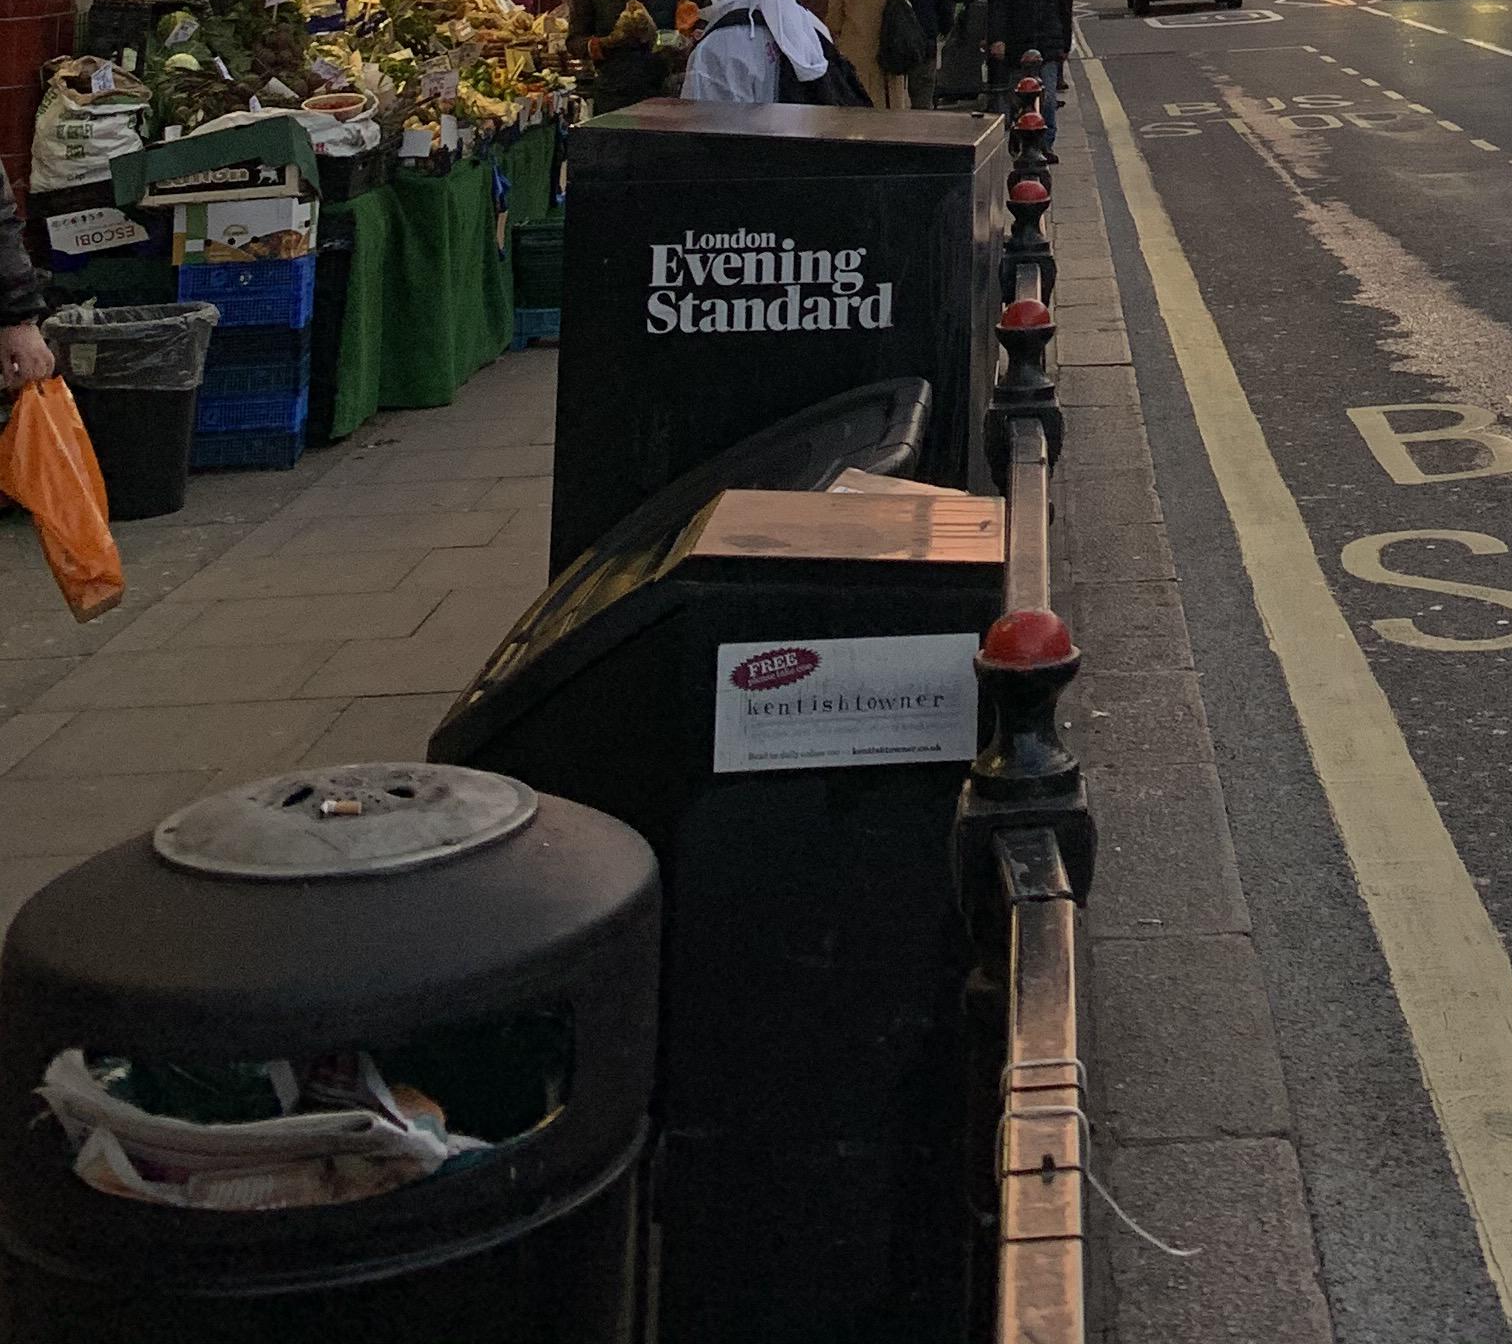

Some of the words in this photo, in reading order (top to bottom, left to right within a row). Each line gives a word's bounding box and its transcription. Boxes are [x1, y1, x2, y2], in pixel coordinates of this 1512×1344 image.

[1162, 93, 1355, 117] BUS
[684, 229, 776, 250] London
[648, 238, 867, 295] Evening
[646, 282, 893, 334] Standard
[748, 651, 799, 678] FREE
